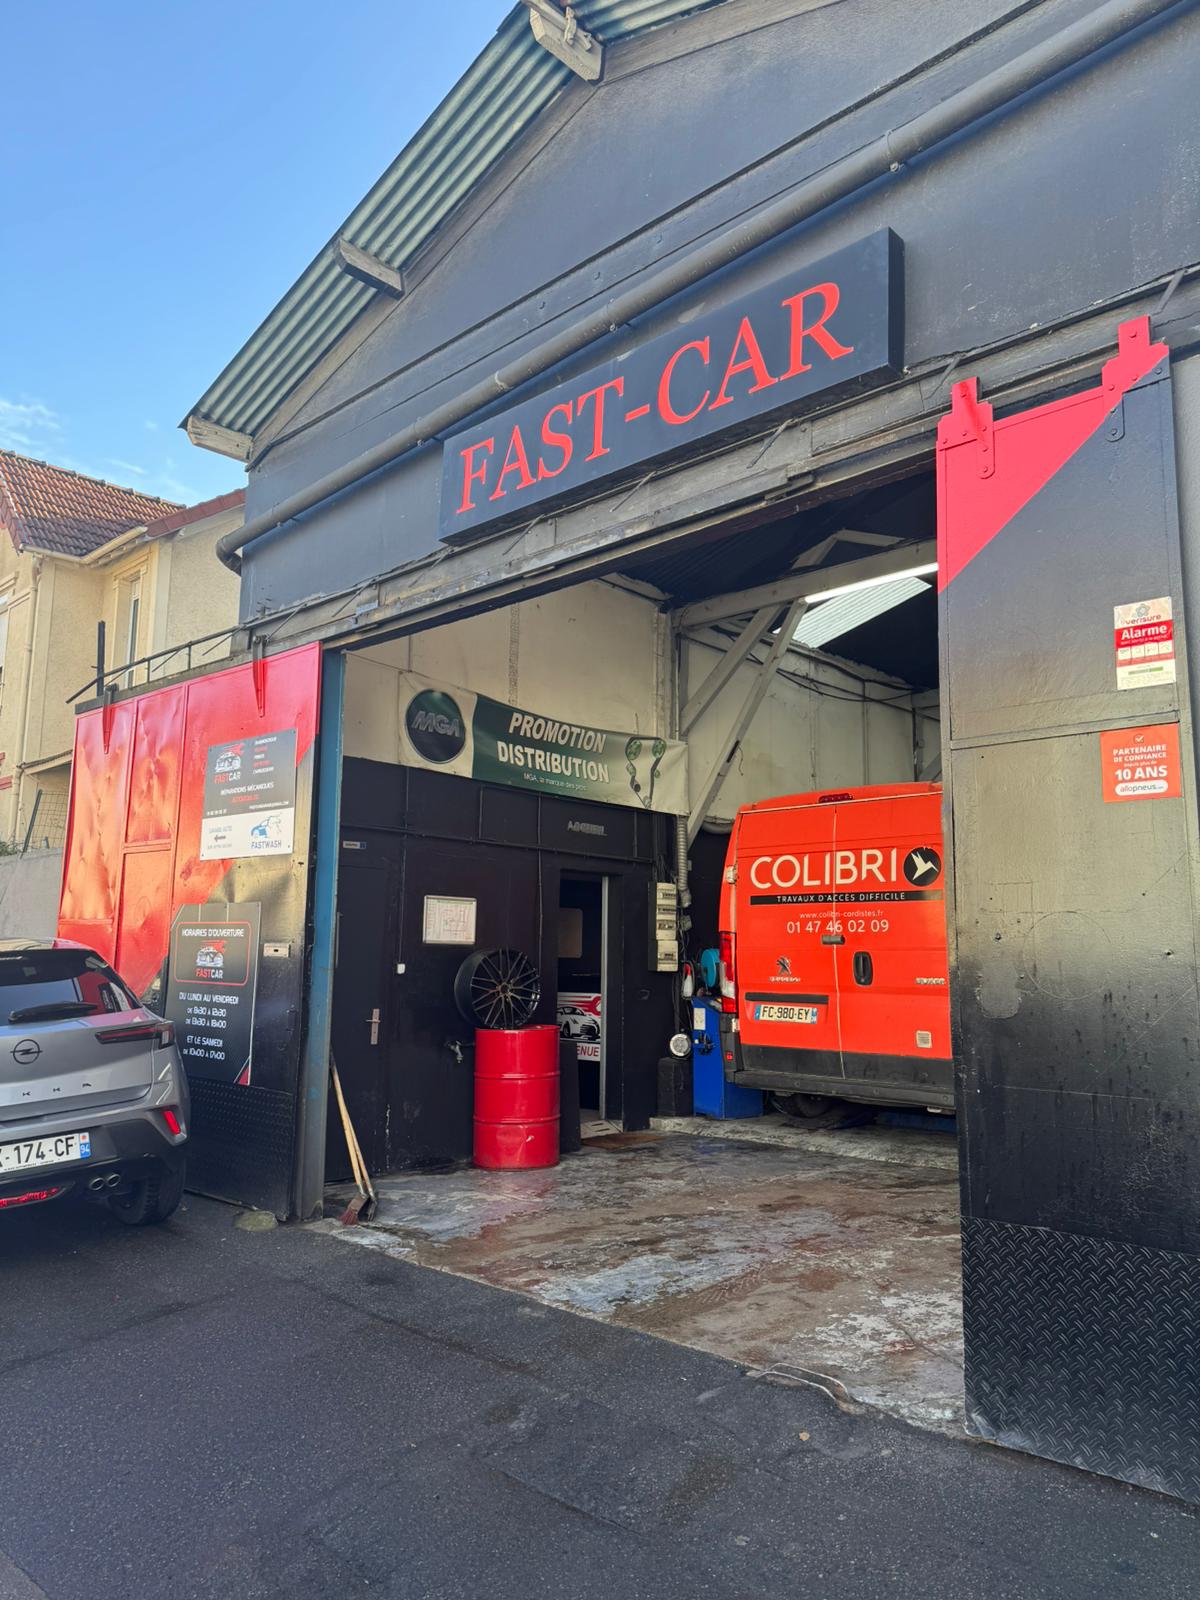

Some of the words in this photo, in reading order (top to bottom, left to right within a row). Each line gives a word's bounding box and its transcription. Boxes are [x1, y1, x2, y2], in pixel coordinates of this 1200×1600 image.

[456, 282, 855, 515] FAST-CAR
[1121, 625, 1168, 641] Alarme
[411, 710, 461, 738] MGA
[508, 711, 607, 753] PROMOTION
[1113, 744, 1167, 756] PARTENAIRE
[1124, 752, 1167, 762] CONFIANCE
[497, 741, 610, 783] DISTRIBUTION
[1115, 769, 1132, 781] 10
[1134, 766, 1168, 780] ANS
[251, 840, 282, 850] FASTWASH
[750, 847, 898, 889] COLIBRI
[777, 895, 815, 903] TRAVAUX
[860, 892, 906, 900] DIFFICILE
[181, 928, 207, 937] HORAIRES
[208, 928, 245, 938] D'OUVERTURE
[787, 921, 800, 934] 01
[806, 921, 820, 933] 47
[826, 920, 844, 933] 46
[848, 920, 866, 932] 02
[871, 919, 889, 932] 09
[195, 968, 224, 980] FASTCAR
[212, 994, 239, 1005] VENDREDI
[762, 1006, 811, 1021] FC-980-EY
[80, 1144, 90, 1154] 94
